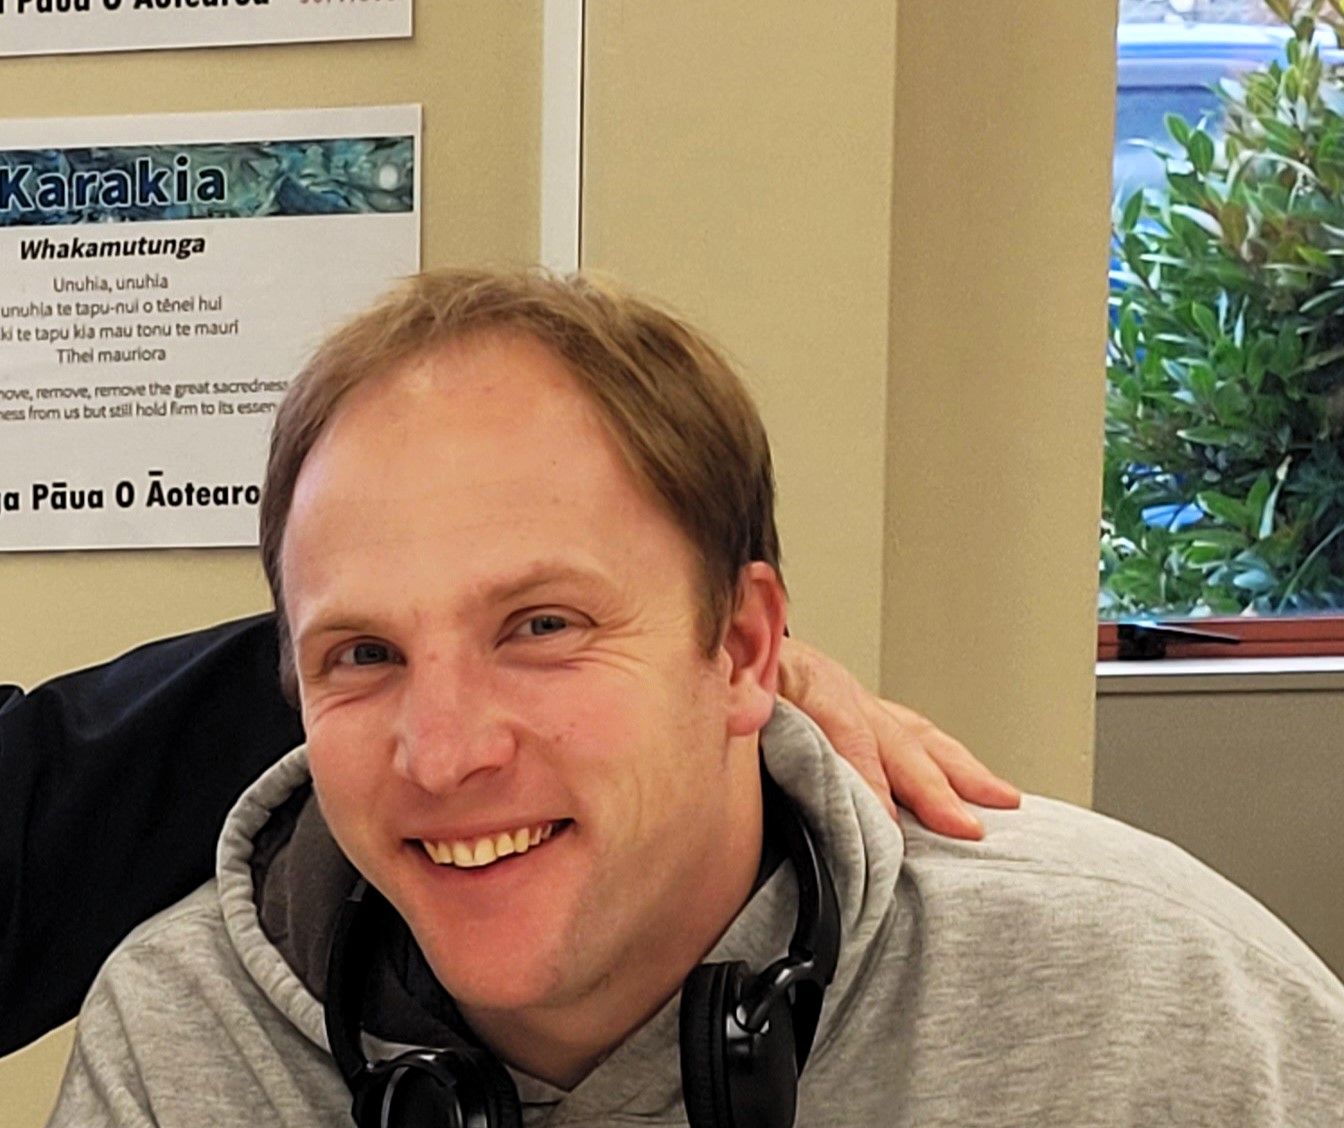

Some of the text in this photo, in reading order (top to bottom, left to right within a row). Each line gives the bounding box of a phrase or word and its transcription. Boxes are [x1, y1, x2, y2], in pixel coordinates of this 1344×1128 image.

[19, 237, 206, 260] Whakamutunga
[52, 274, 169, 294] Unuhia, unuhia
[0, 302, 53, 320] unuhia
[56, 303, 73, 318] te
[75, 300, 139, 319] tapu-nui
[198, 296, 223, 311] hui
[17, 328, 33, 342] te
[35, 327, 69, 346] tapu
[73, 324, 96, 339] kia
[99, 327, 134, 340] mau
[136, 323, 172, 338] tonu
[175, 323, 192, 337] te
[194, 317, 239, 336] mauri
[97, 347, 167, 364] mauriora
[35, 387, 91, 401] remove,
[94, 386, 147, 399] remove
[149, 382, 172, 397] the
[174, 382, 210, 398] great
[213, 378, 289, 396] sacredness
[28, 406, 62, 421] from
[64, 410, 80, 420] us
[83, 404, 106, 418] but
[109, 403, 134, 418] still
[135, 401, 168, 417] hold
[169, 401, 198, 415] firm
[200, 402, 216, 415] to
[218, 401, 235, 414] its
[237, 403, 276, 415] essen
[31, 480, 104, 512] Pāua
[114, 480, 135, 508] O
[145, 470, 261, 508] Āotearo
